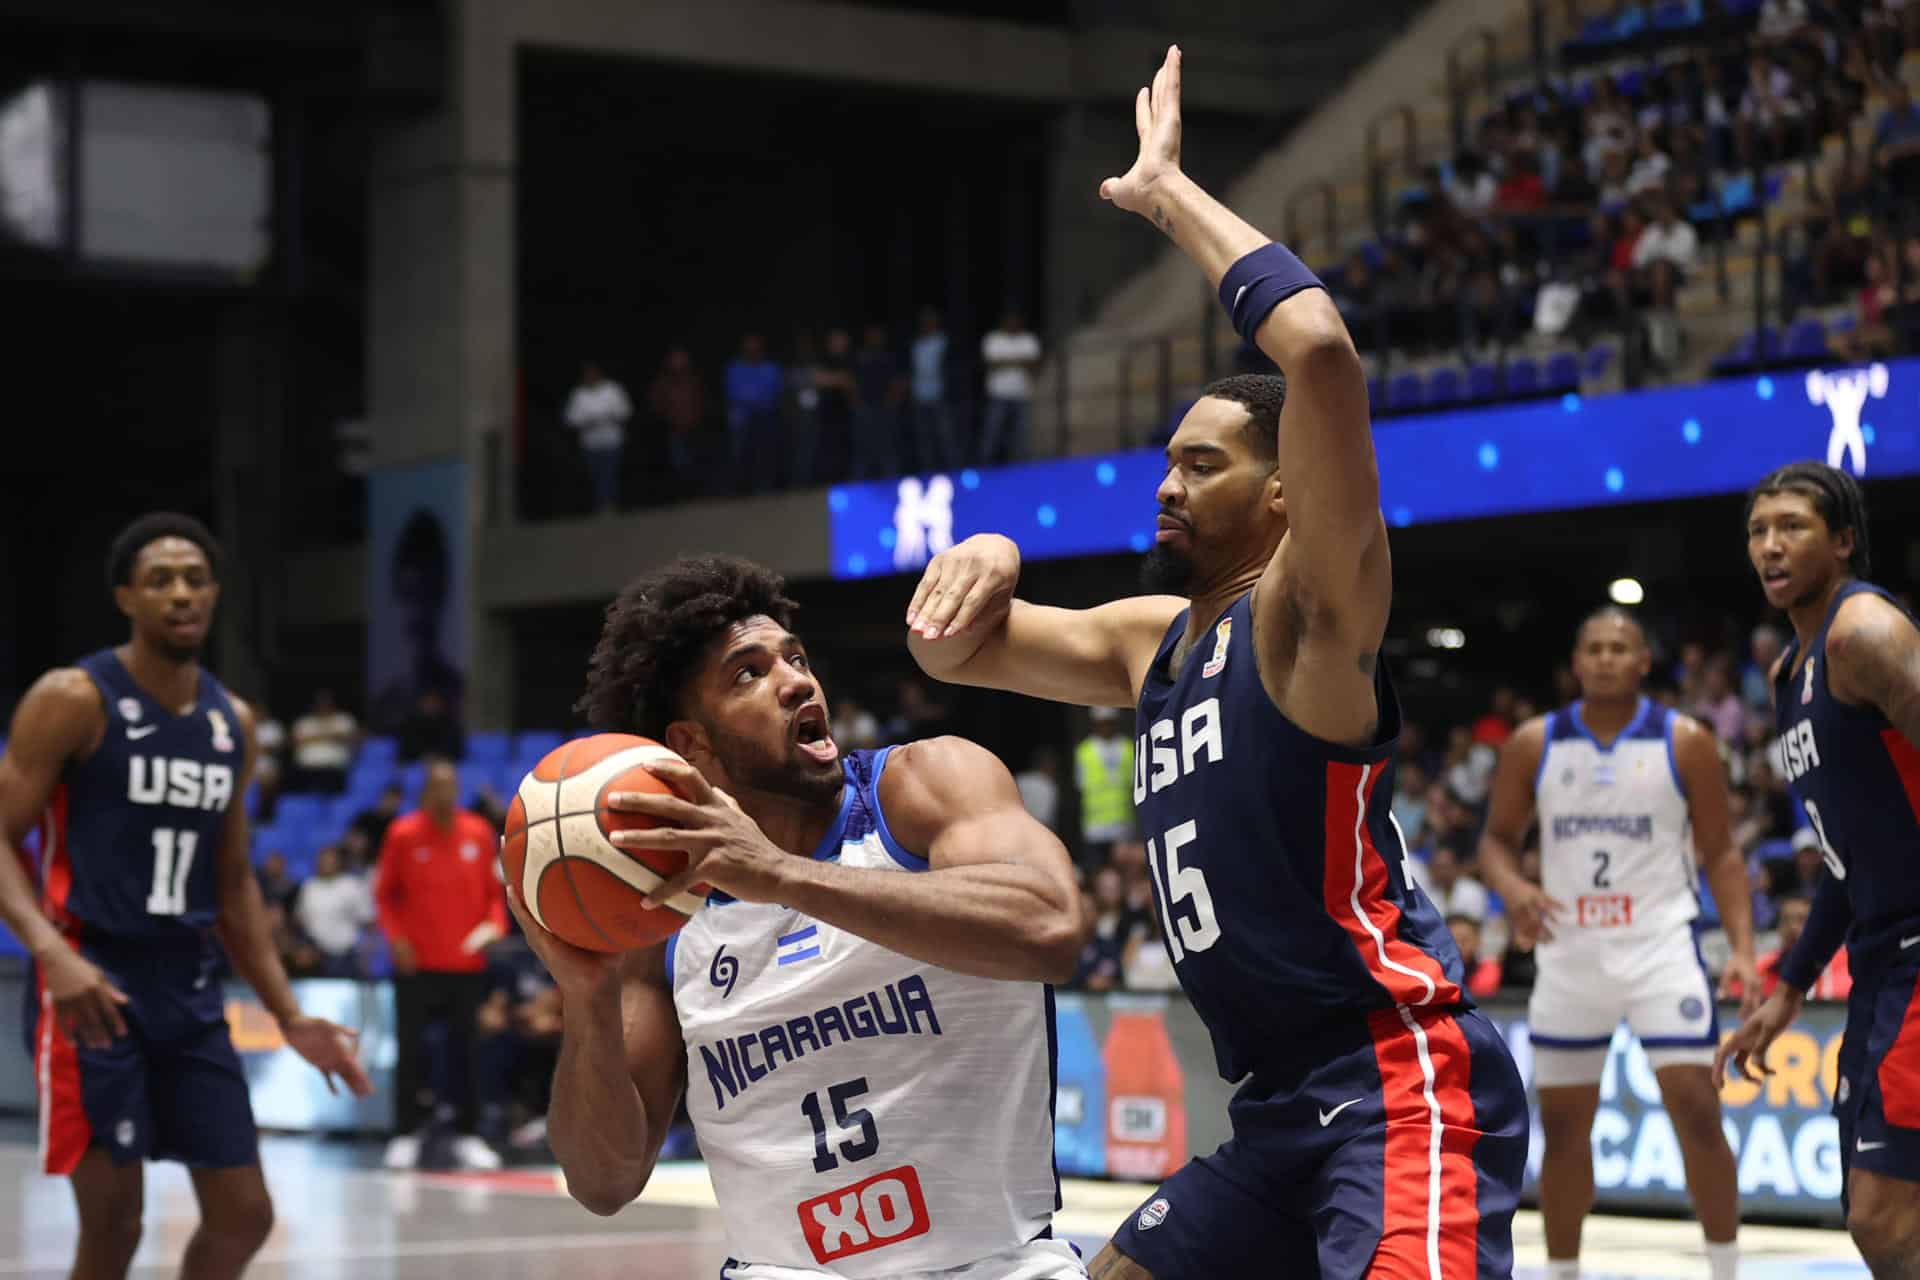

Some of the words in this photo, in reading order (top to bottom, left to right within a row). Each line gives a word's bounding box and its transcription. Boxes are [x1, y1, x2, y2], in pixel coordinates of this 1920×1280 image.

[128, 755, 234, 812] USA
[1133, 697, 1224, 807] USA
[146, 827, 199, 915] 11
[1147, 818, 1222, 965] 15
[1593, 850, 1611, 889] 2
[699, 973, 943, 1111] NICARAGUA
[801, 1076, 879, 1174] 15
[811, 1176, 915, 1255] XO
